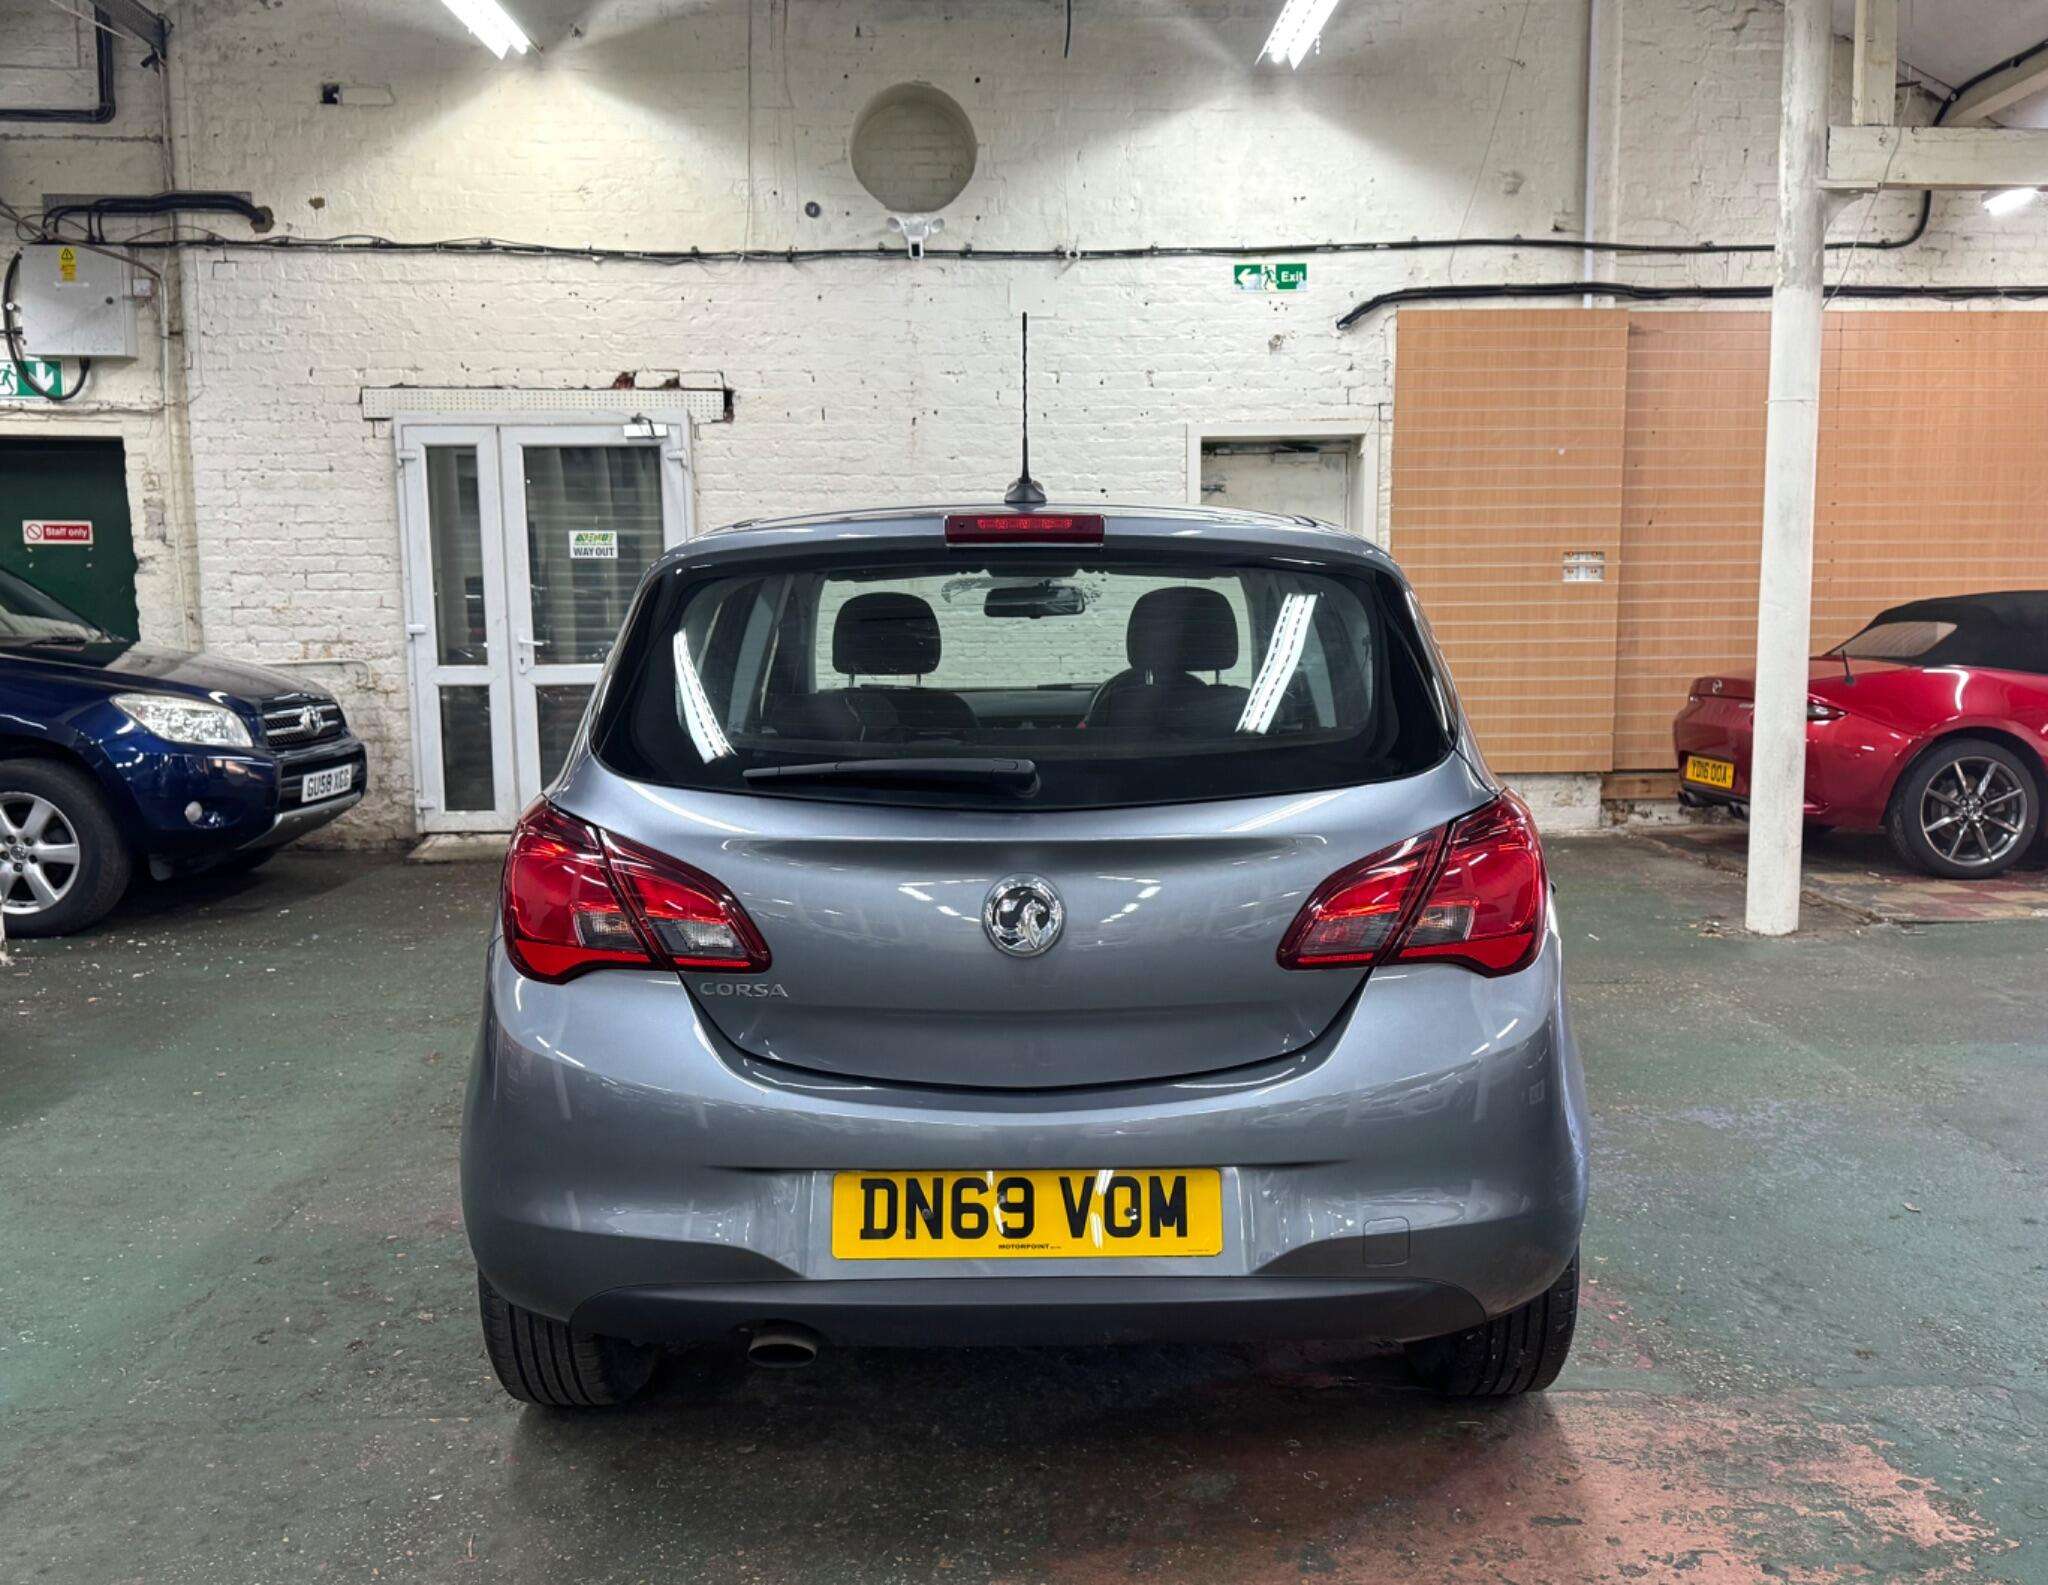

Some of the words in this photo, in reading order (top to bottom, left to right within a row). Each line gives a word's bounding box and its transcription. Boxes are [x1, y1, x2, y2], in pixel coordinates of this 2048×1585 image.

[1281, 270, 1304, 283] Exit
[46, 527, 66, 536] Staff
[69, 527, 88, 538] only
[573, 547, 593, 556] WAY
[595, 547, 614, 556] OUT
[307, 774, 332, 797] GU58
[700, 982, 789, 998] CORSA
[860, 1177, 1034, 1240] DN69
[1060, 1176, 1187, 1239] VOM
